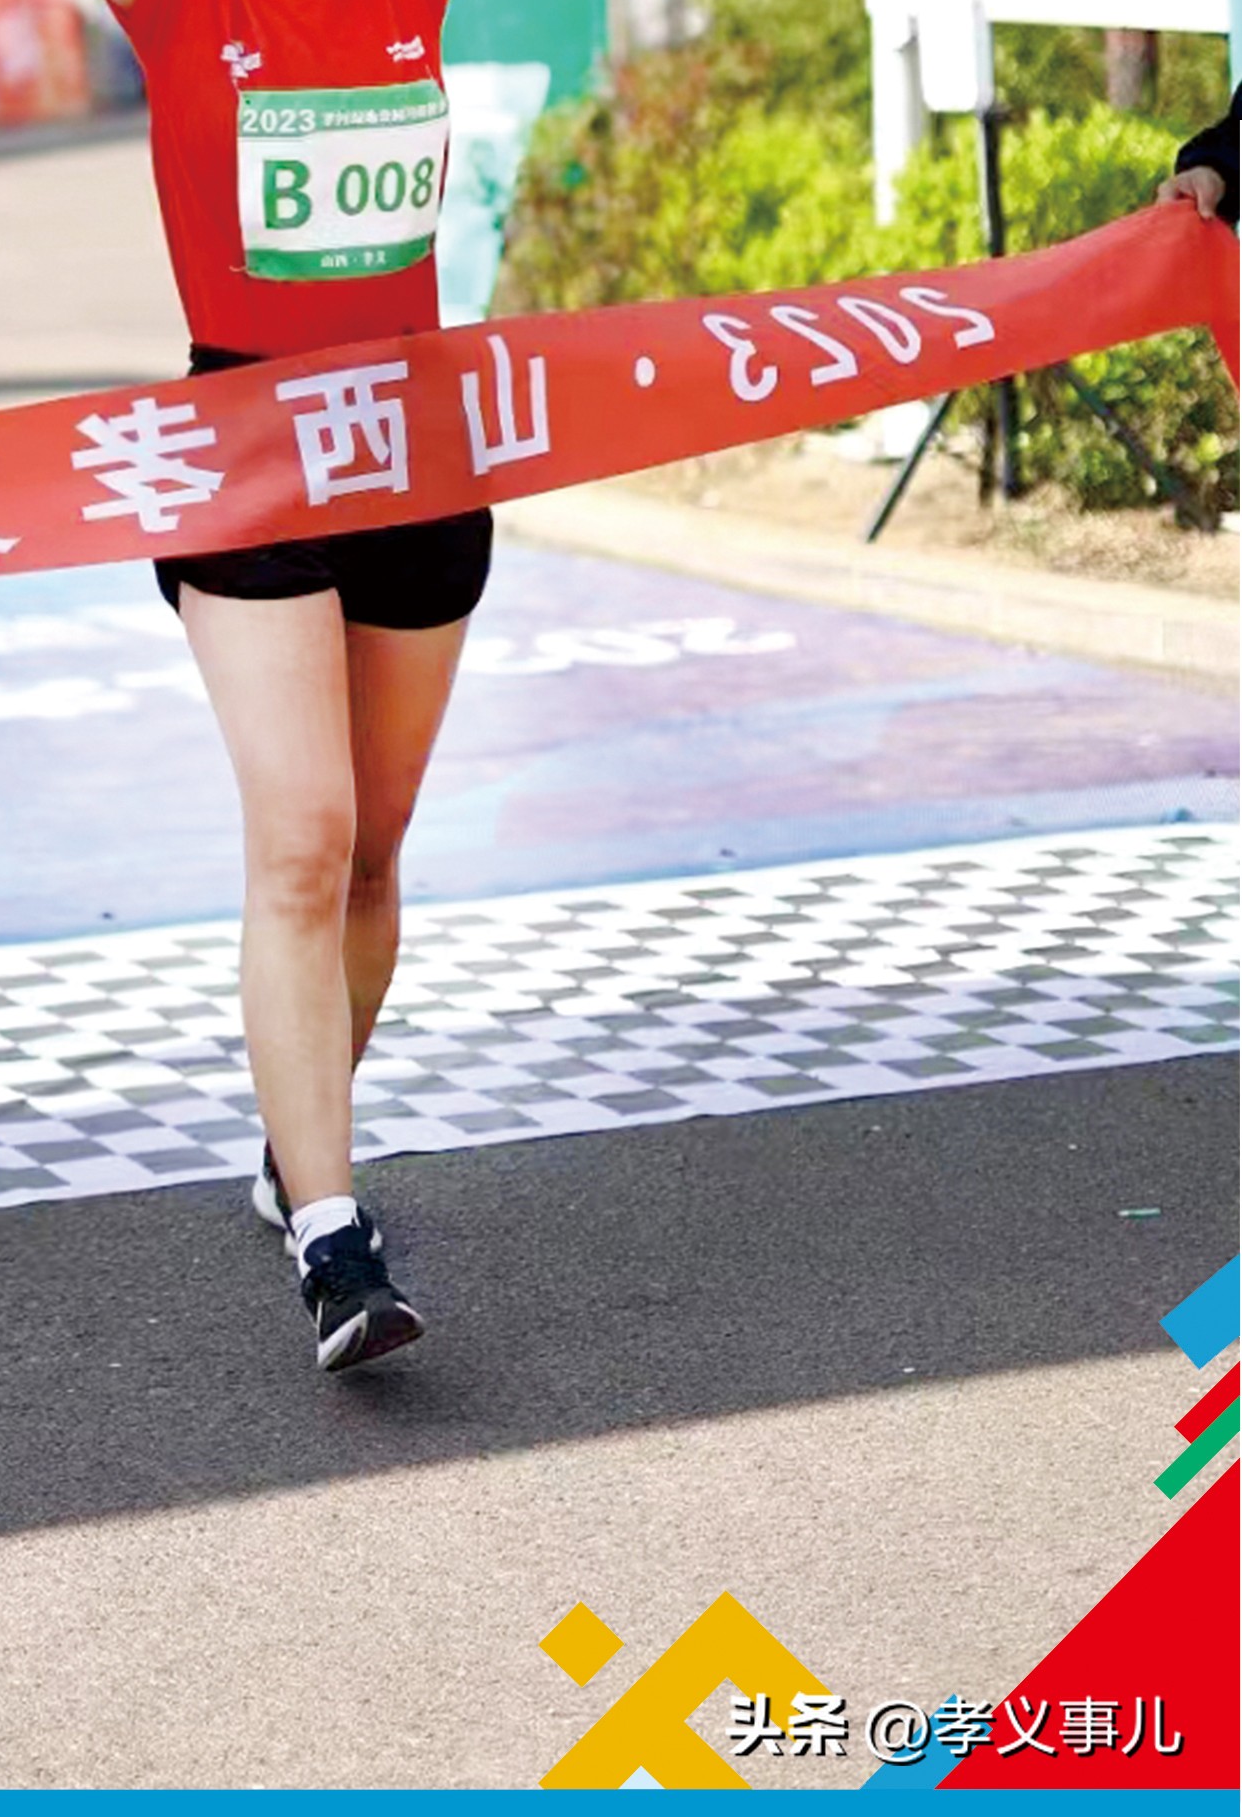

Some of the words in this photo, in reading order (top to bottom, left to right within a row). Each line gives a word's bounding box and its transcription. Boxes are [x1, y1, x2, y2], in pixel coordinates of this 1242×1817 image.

[243, 108, 316, 133] 2023
[262, 159, 313, 230] B
[335, 156, 435, 216] 008
